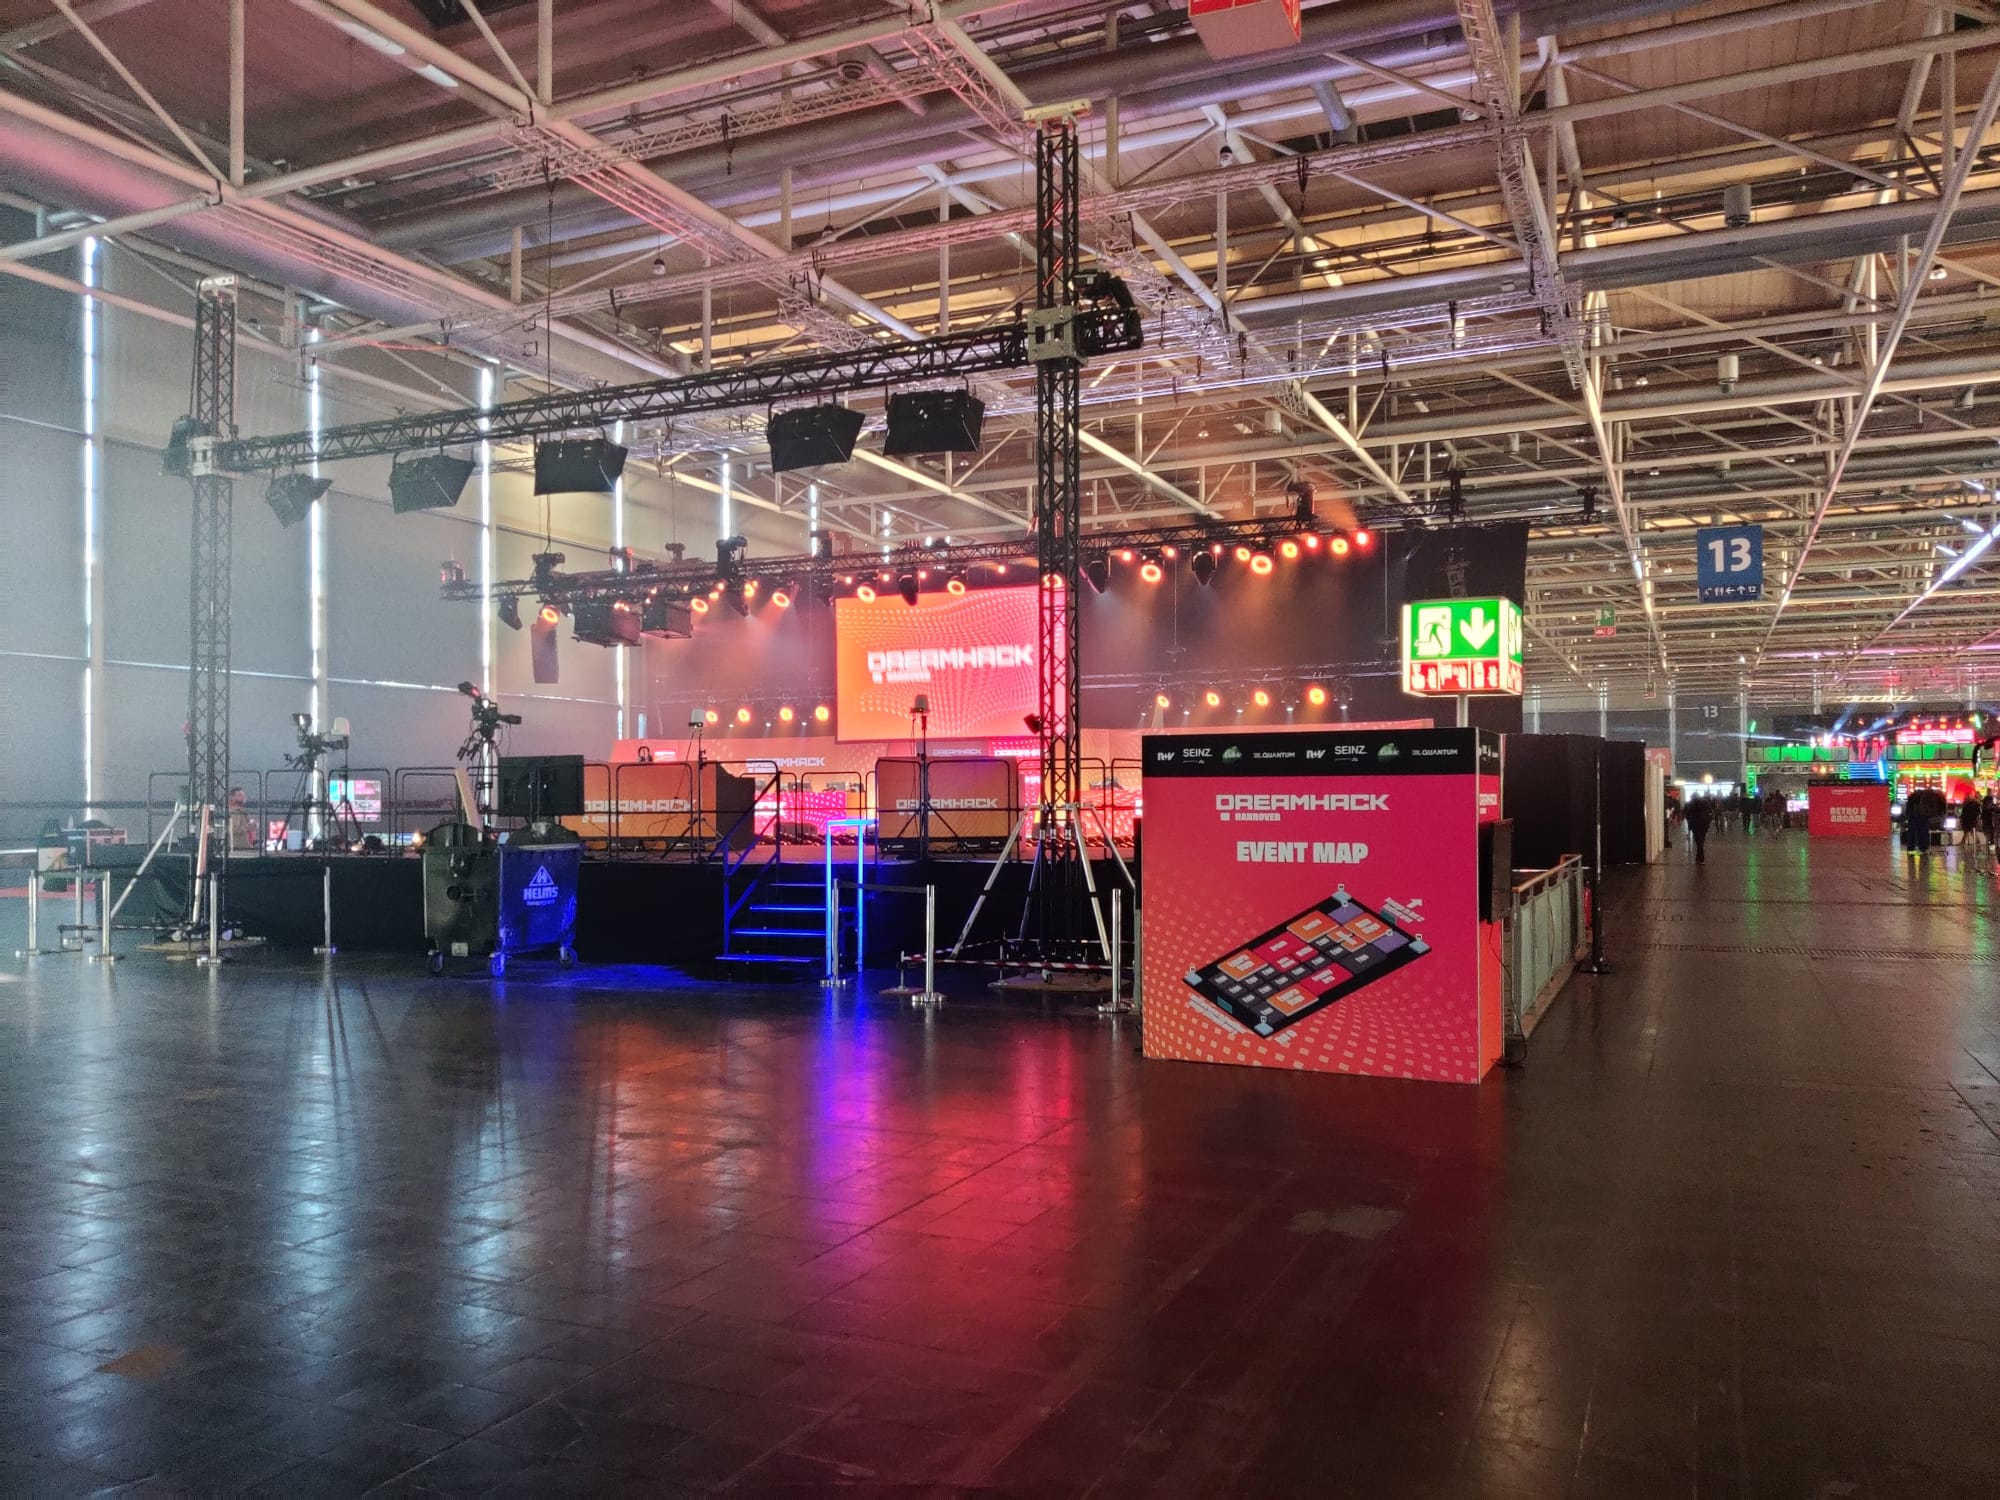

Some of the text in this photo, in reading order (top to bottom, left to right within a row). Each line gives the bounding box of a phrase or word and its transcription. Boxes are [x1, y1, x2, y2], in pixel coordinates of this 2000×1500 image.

[1708, 538, 1752, 572] 13
[868, 644, 1034, 673] DREAMHACK
[1702, 706, 1719, 718] 13
[896, 798, 998, 809] DRAMHACK
[1215, 794, 1391, 811] DREAMHACK
[1236, 841, 1369, 864] EVENT MAP
[523, 886, 559, 900] HELMS
